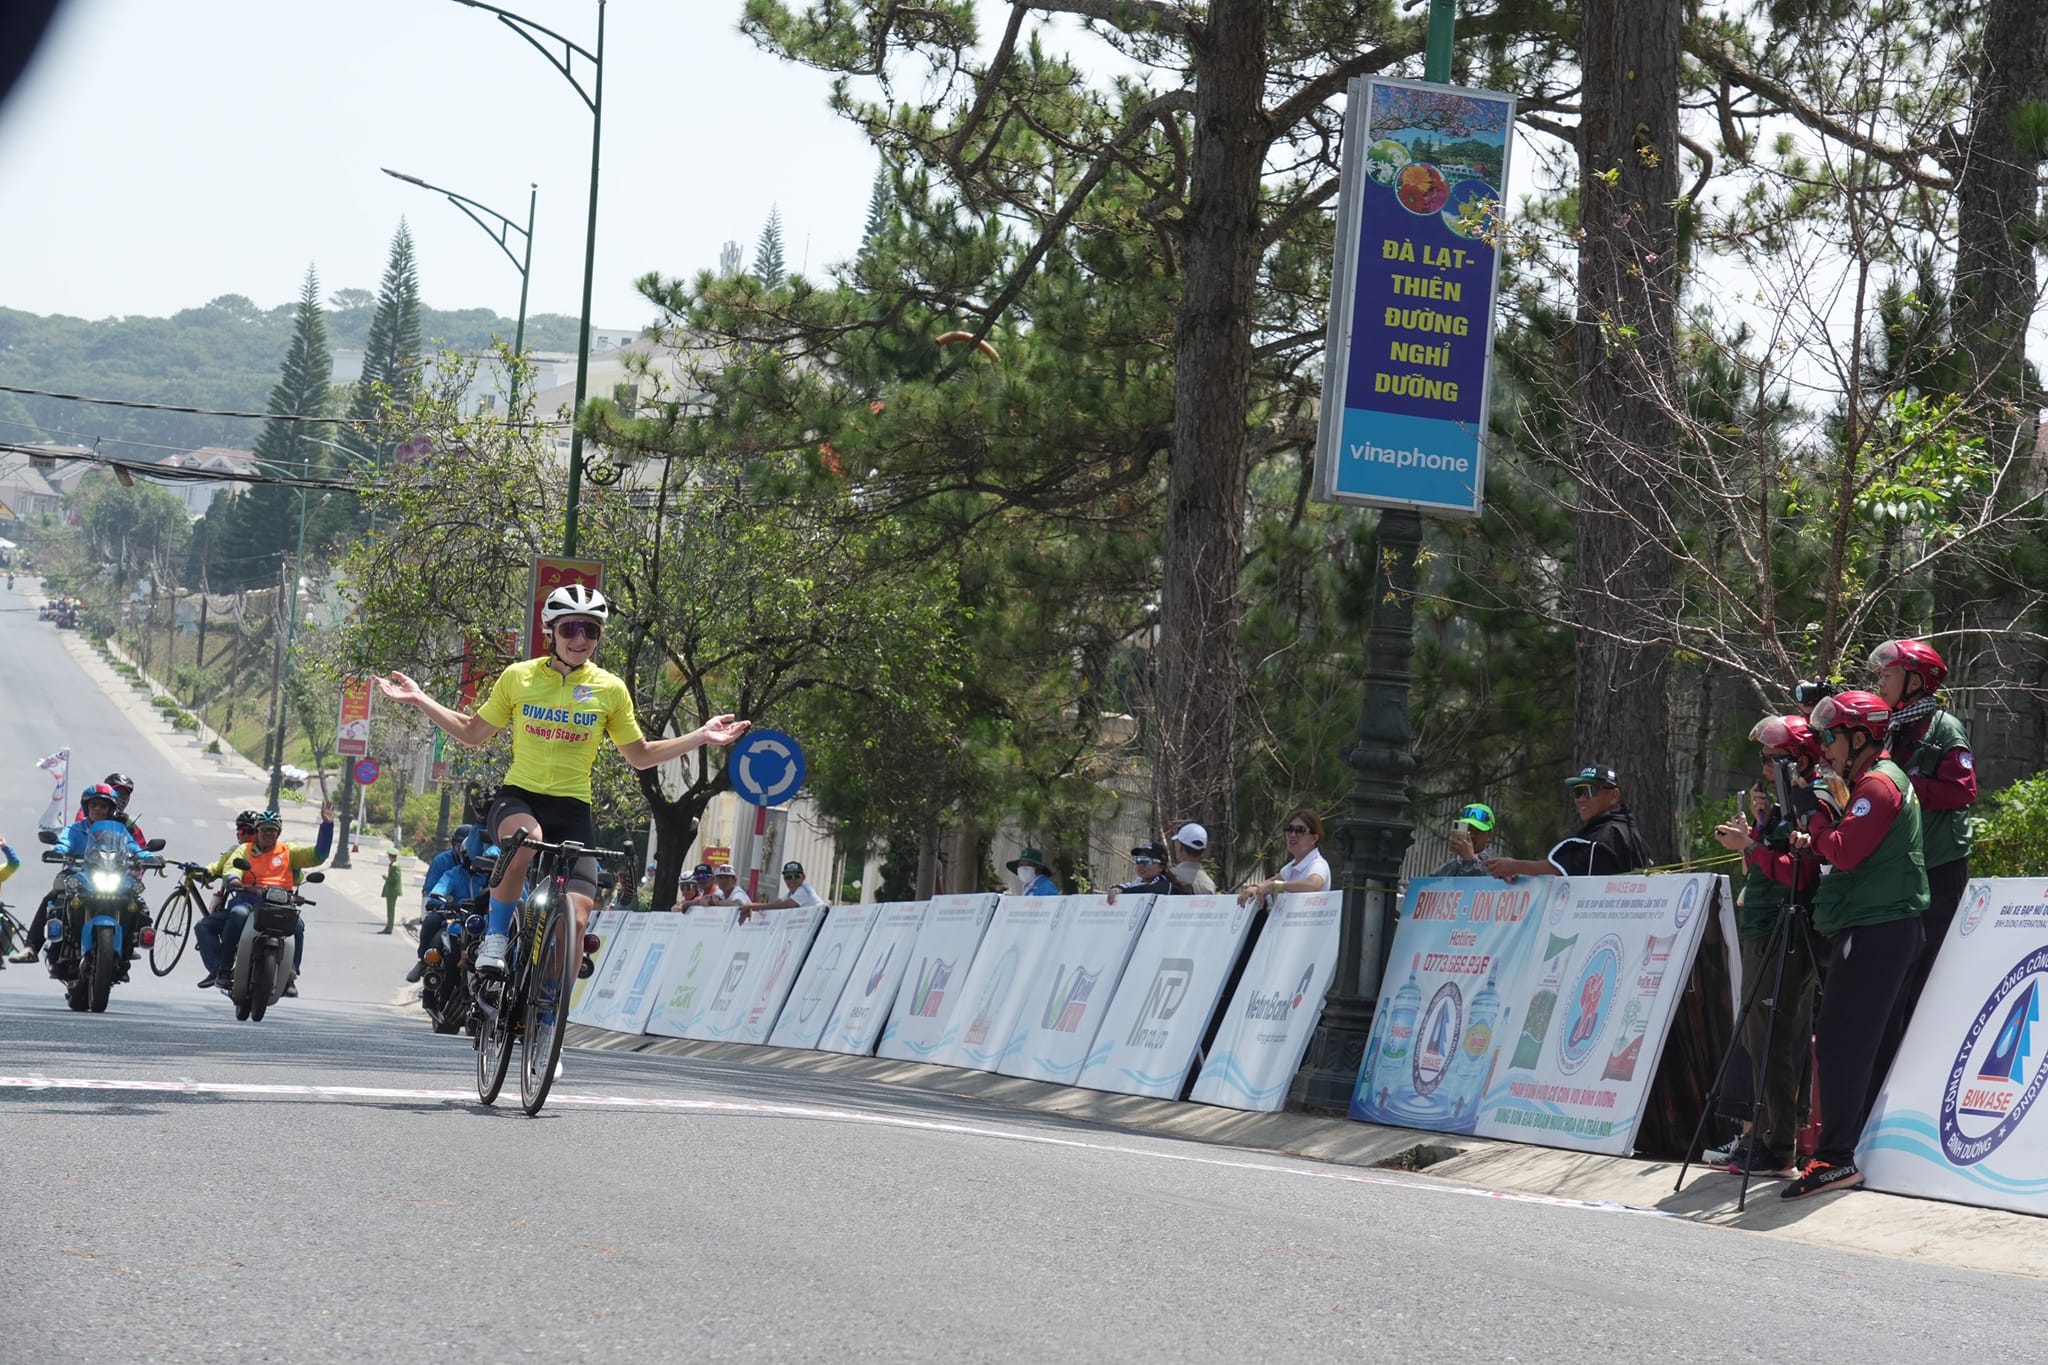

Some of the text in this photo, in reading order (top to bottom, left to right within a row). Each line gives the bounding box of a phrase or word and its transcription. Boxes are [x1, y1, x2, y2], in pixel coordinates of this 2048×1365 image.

[1382, 238, 1415, 262] ĐÀ
[1391, 274, 1461, 302] THIÊN
[1384, 306, 1468, 336] ĐƯỜNG
[1390, 341, 1451, 367] NGHỈ
[1375, 372, 1459, 402] DƯỠNG
[1350, 441, 1469, 472] vinaphone
[523, 704, 597, 726] BIWASE CUP
[1412, 891, 1463, 921] BIWASE
[1470, 891, 1496, 922] ION
[1495, 891, 1531, 922] GOLD
[1449, 929, 1477, 947] Hotline
[1945, 1066, 1963, 1113] CÔNG
[1958, 1041, 1973, 1062] TY
[1972, 1013, 1987, 1036] CP
[1994, 966, 2025, 1002] TỔNG
[1962, 1089, 2013, 1111] BIWASE
[1947, 1131, 1992, 1160] BÌNH DƯƠNG
